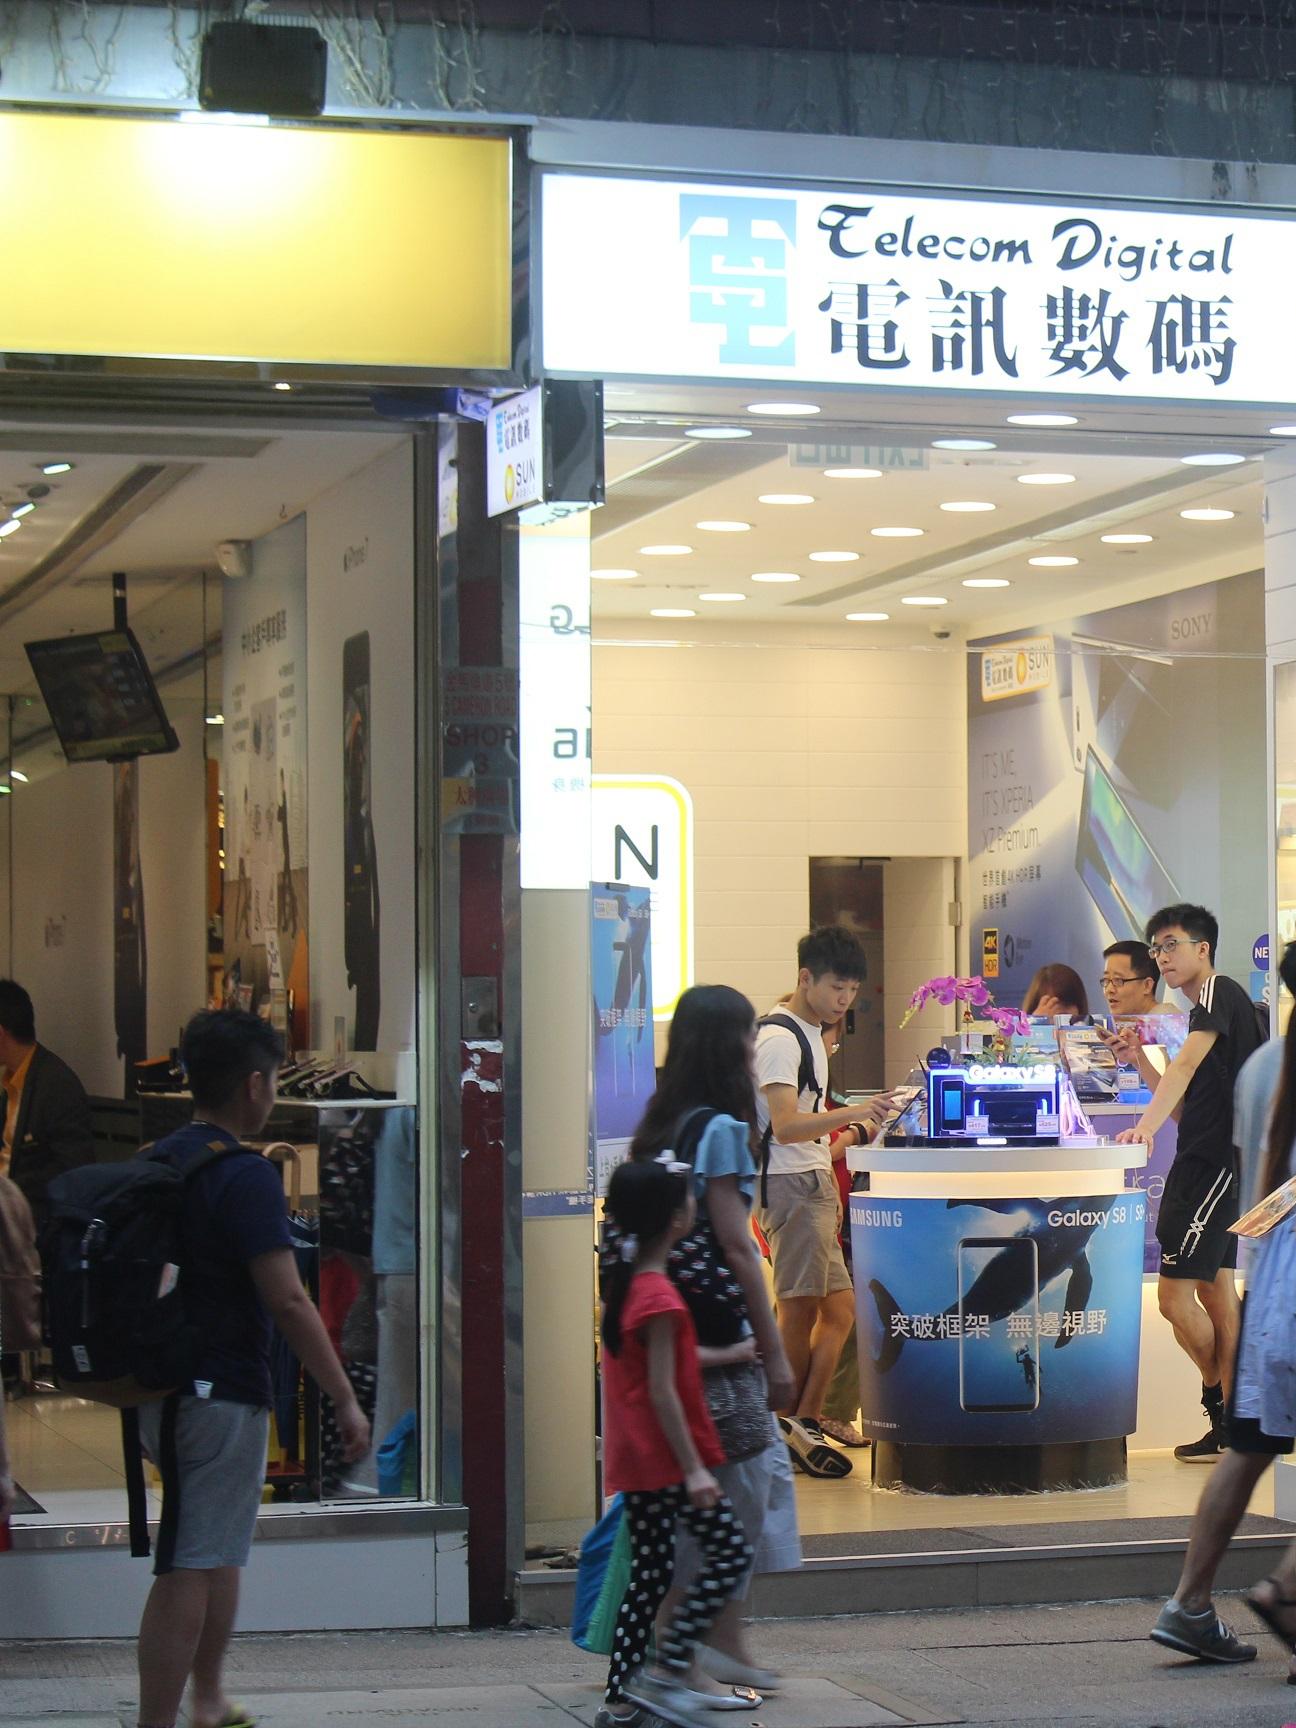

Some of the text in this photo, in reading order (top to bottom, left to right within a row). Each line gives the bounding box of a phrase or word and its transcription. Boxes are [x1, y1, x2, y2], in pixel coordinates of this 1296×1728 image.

[817, 204, 1235, 282] Telecom Digital
[817, 278, 1238, 387] 電訊數碼
[516, 458, 536, 486] SUN
[1170, 614, 1212, 640] SONY
[984, 935, 997, 949] 4K
[1254, 947, 1269, 959] NE
[984, 958, 998, 973] HDR
[968, 1064, 1034, 1080] Galaxy
[1047, 1209, 1111, 1230] Galaxy
[1112, 1209, 1126, 1224] S8
[890, 1309, 1107, 1340] 突破框架 無邊視野
